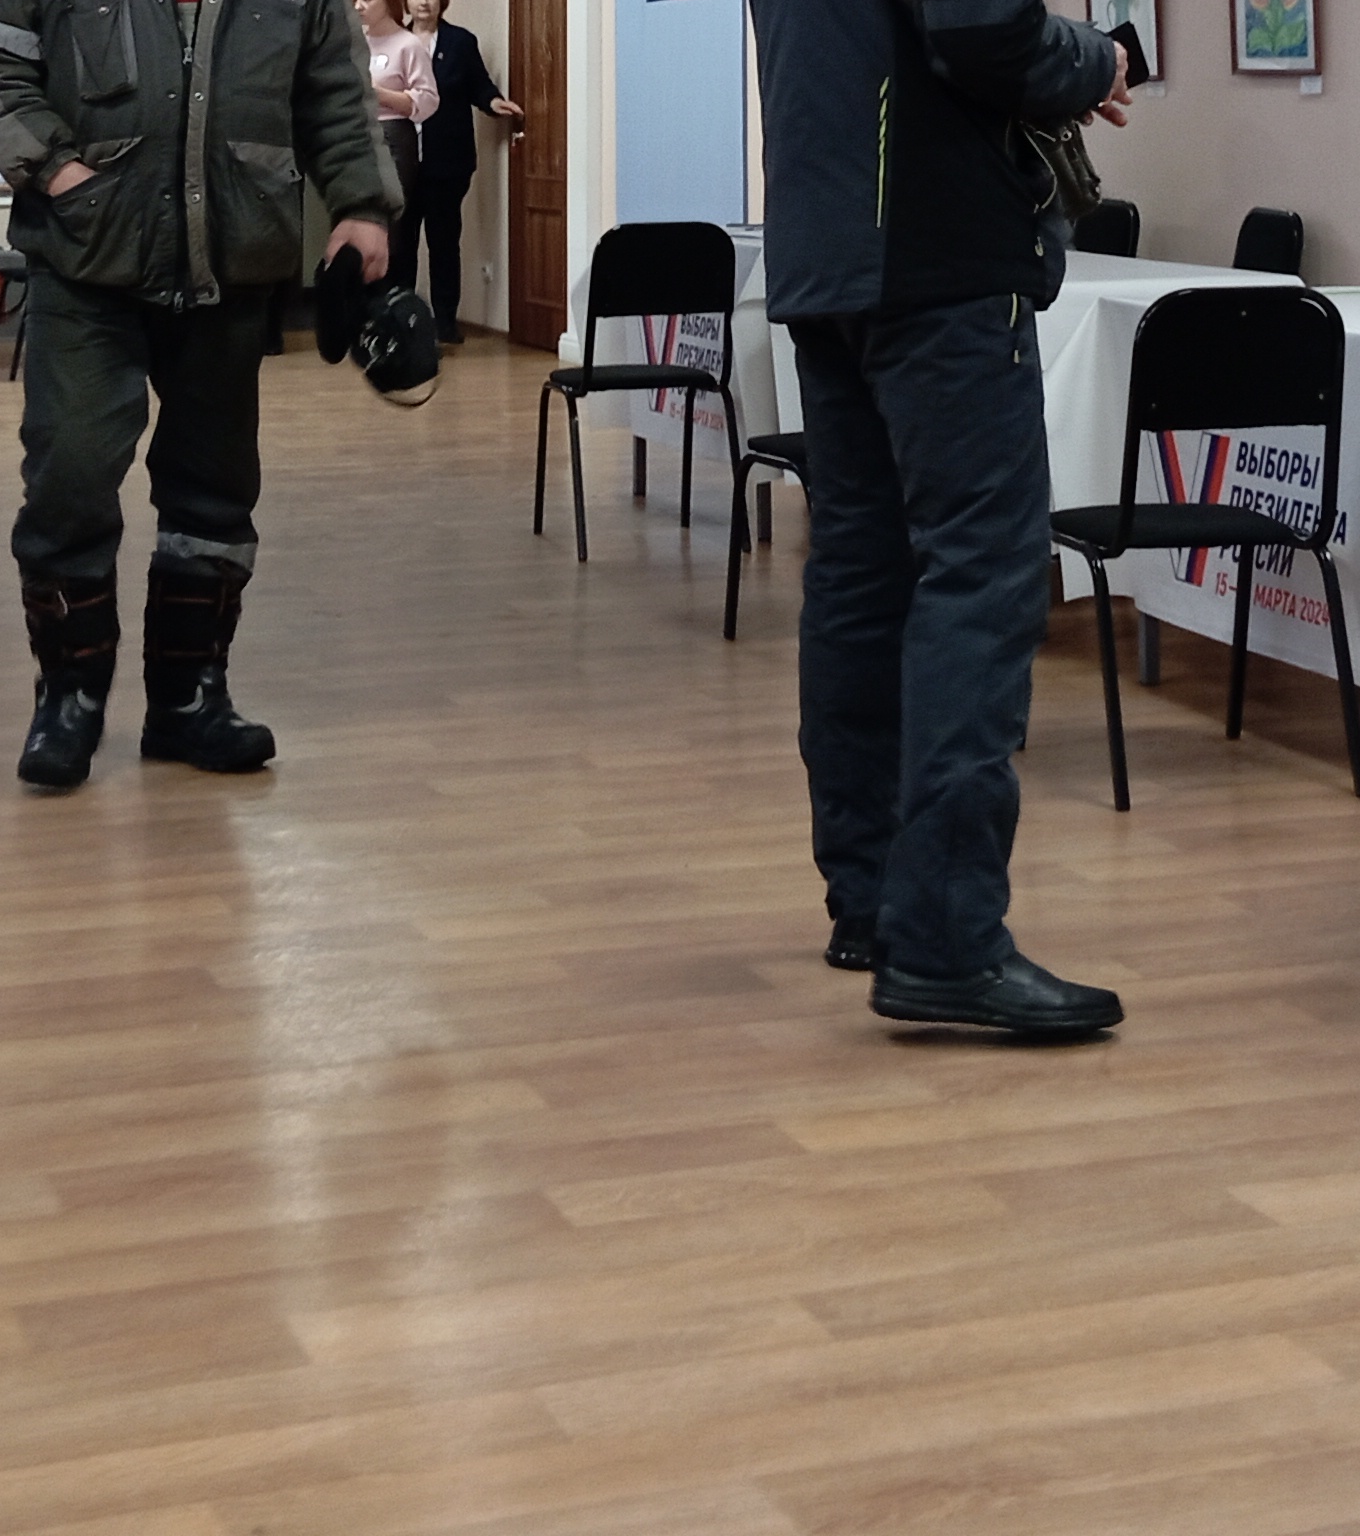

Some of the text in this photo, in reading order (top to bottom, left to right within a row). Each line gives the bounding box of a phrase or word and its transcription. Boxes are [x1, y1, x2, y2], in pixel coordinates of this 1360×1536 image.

[680, 314, 721, 341] ВЫБОРЫ
[1236, 441, 1320, 490] ВЫБОРЫ
[1253, 583, 1296, 619] МАРТА
[1300, 596, 1330, 627] 2024
